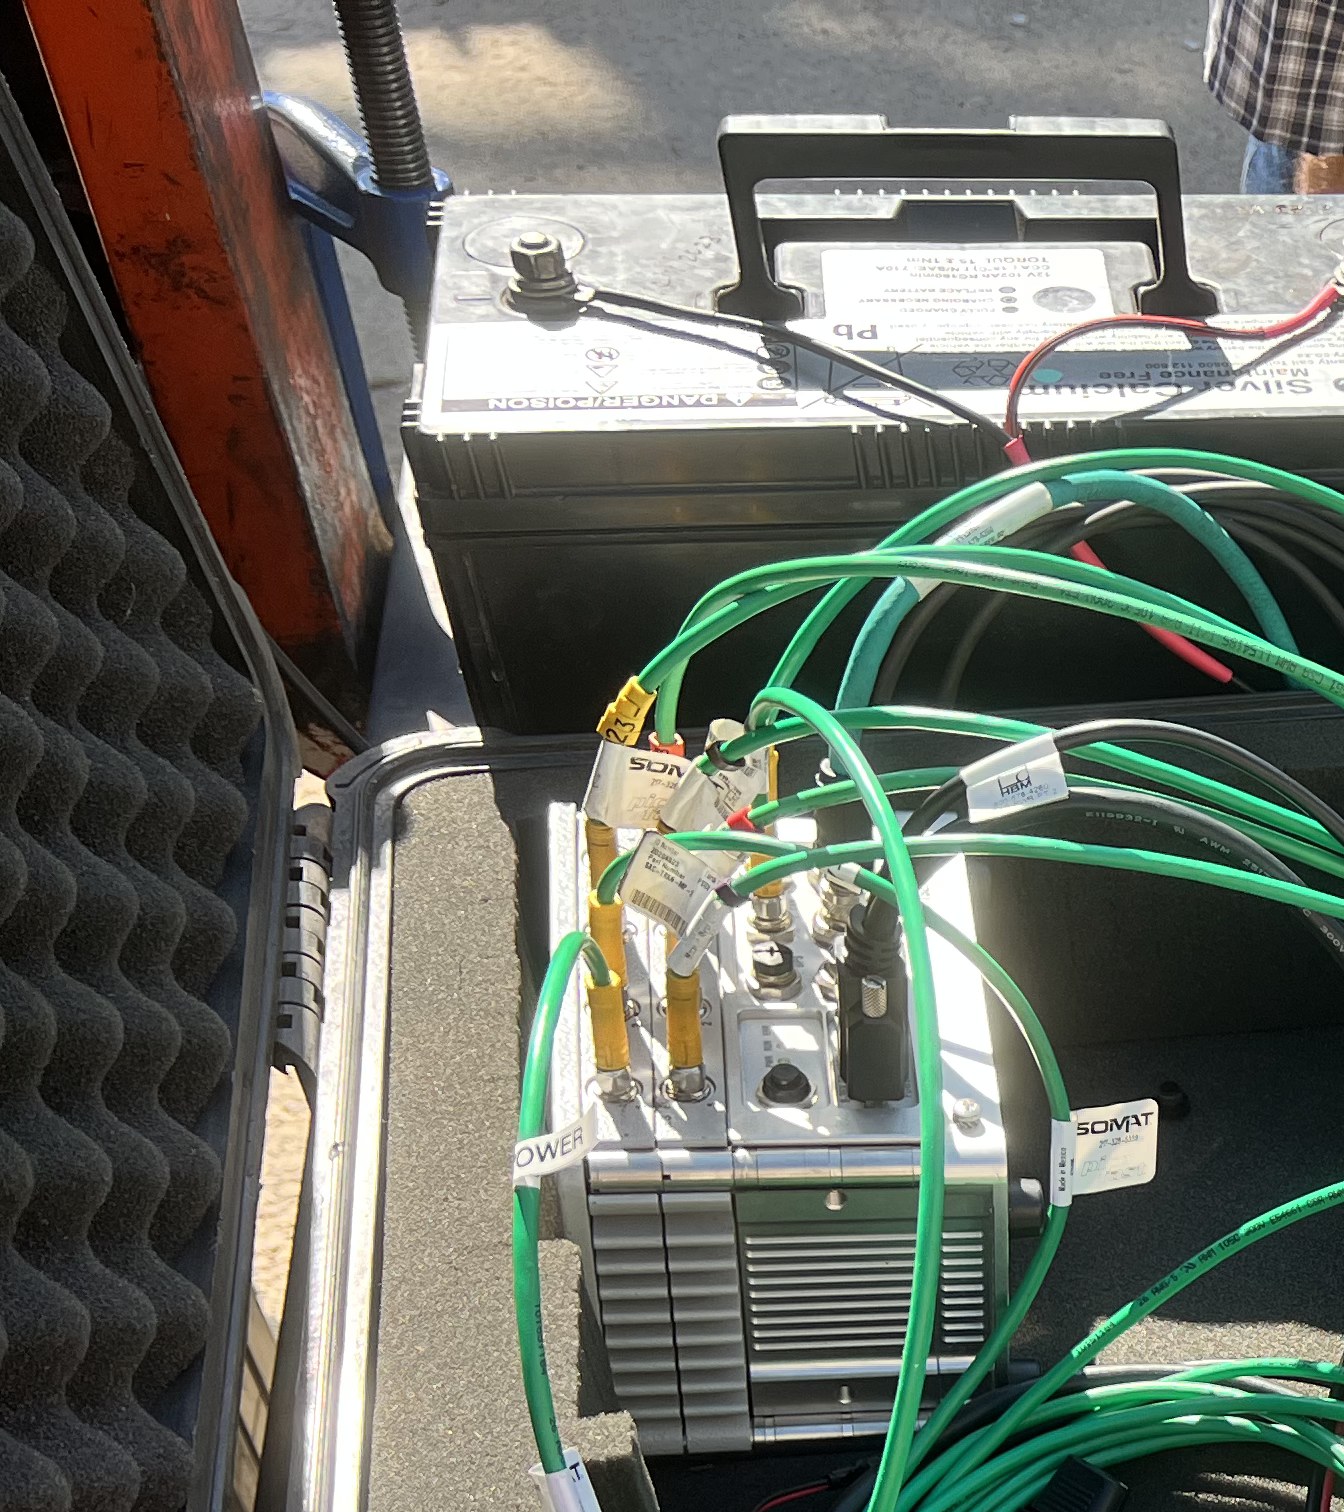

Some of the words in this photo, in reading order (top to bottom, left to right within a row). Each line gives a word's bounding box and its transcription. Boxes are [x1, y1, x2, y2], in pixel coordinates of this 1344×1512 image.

[832, 323, 879, 341] Pb
[1098, 370, 1152, 382] Free
[1159, 368, 1310, 381] Maintenance
[1019, 381, 1194, 399] Calcium
[1194, 379, 1313, 397] Silver
[489, 393, 719, 410] DANGER/POISON
[629, 756, 684, 778] SOM
[1200, 836, 1231, 855] AWM
[1077, 1112, 1154, 1136] SOMAT
[516, 1126, 584, 1168] OWER
